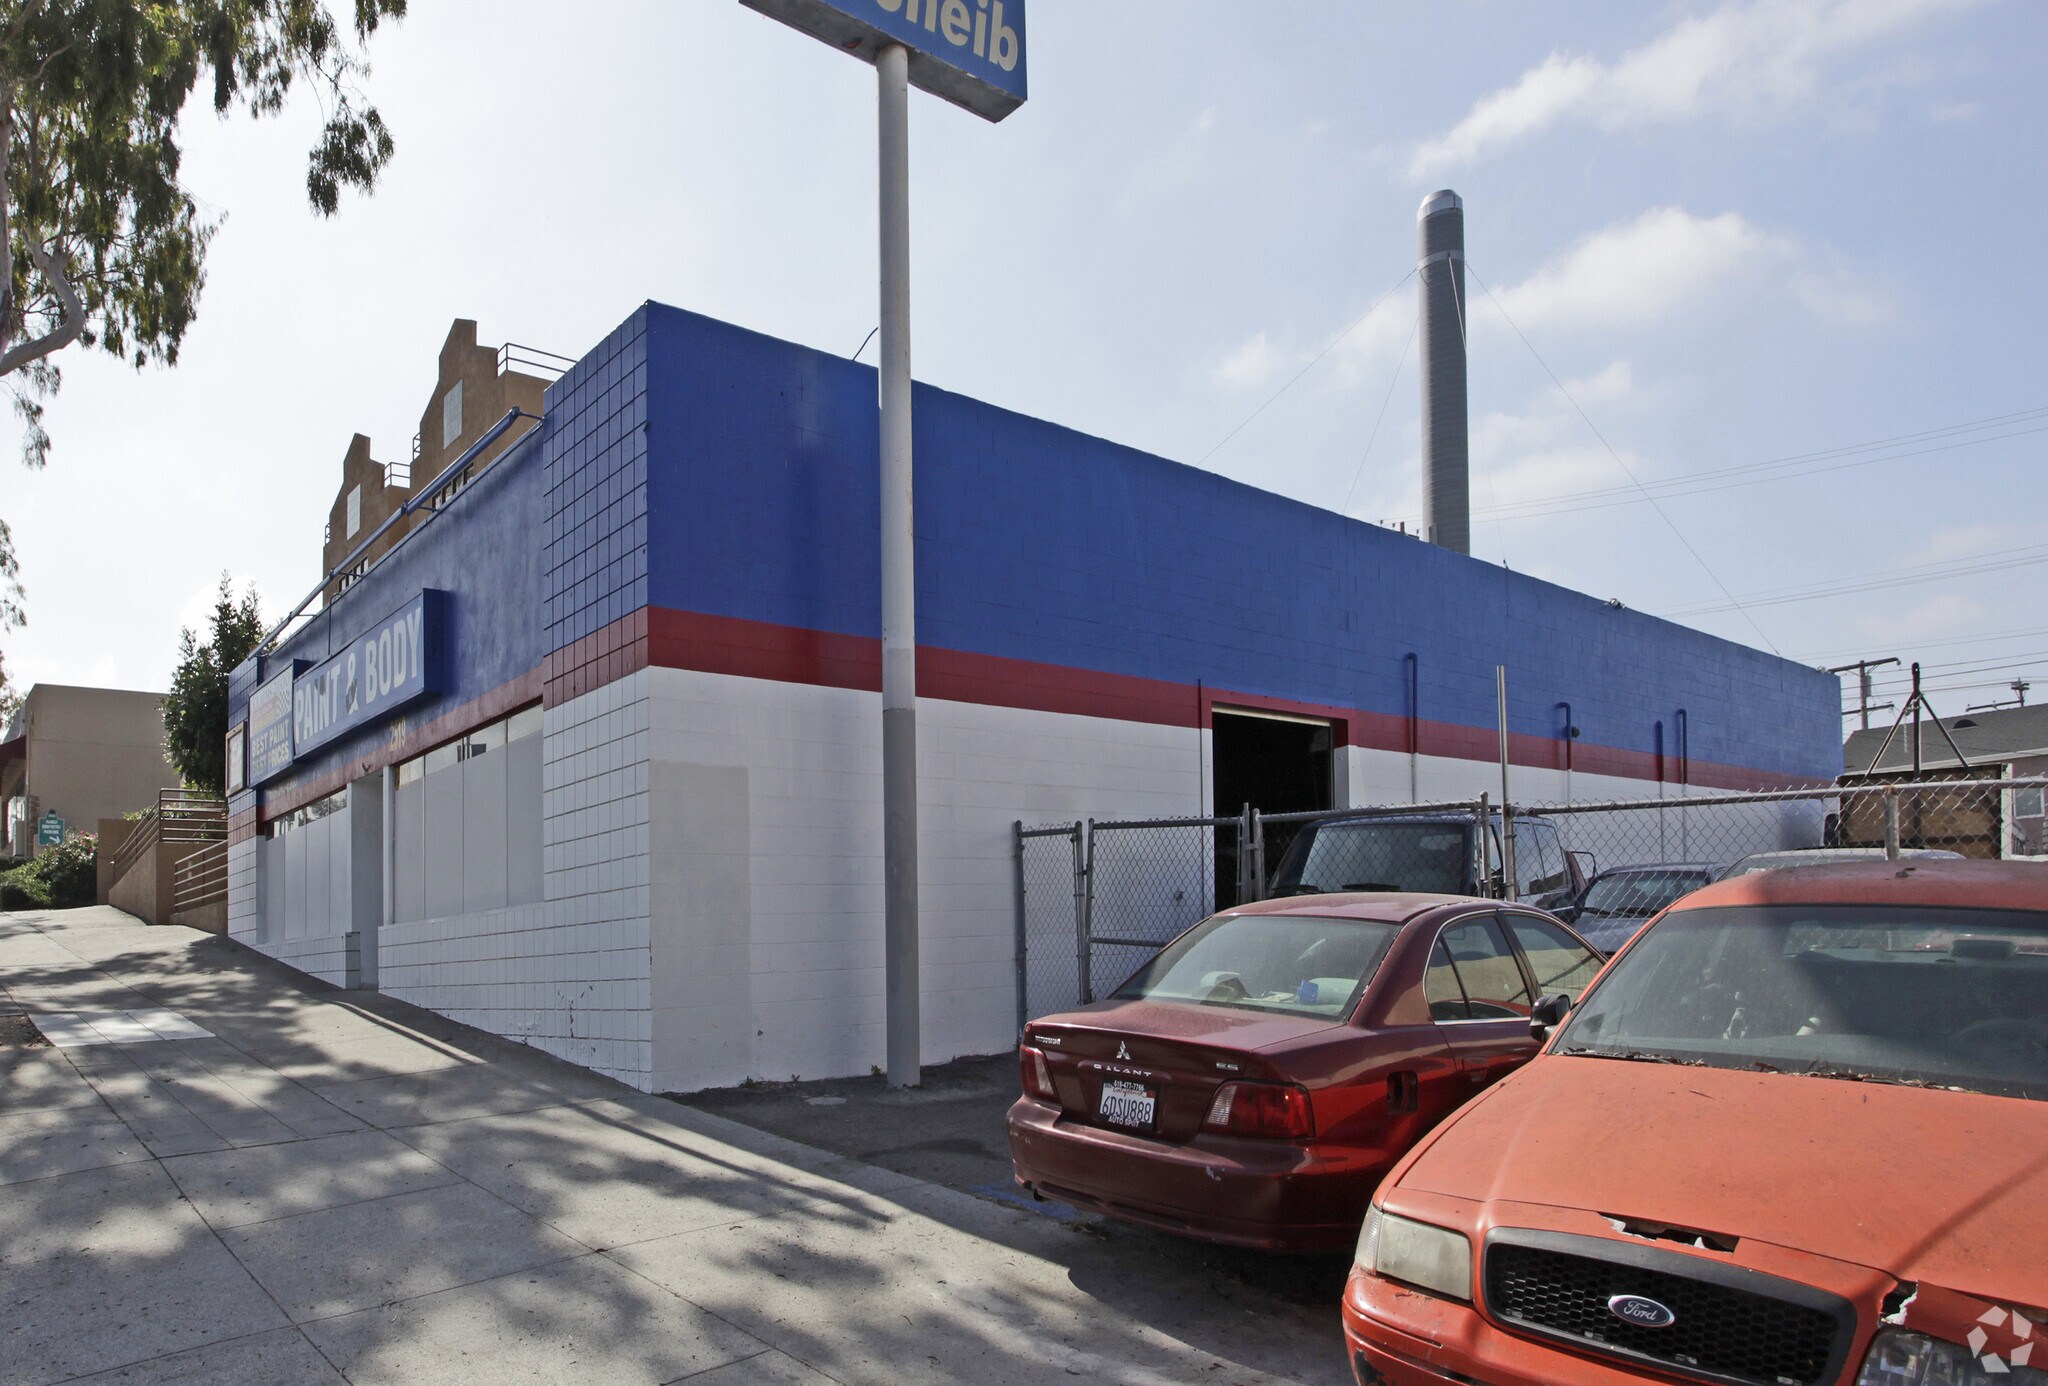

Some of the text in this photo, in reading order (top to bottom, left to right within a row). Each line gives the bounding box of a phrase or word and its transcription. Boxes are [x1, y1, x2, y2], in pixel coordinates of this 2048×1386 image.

[874, 0, 1018, 72] eib
[295, 663, 340, 744] PAINT
[346, 652, 359, 715] &
[366, 606, 421, 705] BODY
[252, 732, 269, 759] BEST
[269, 719, 289, 748] PAINT
[268, 740, 289, 769] PRICES
[1094, 1063, 1152, 1077] GALANT
[1101, 1095, 1152, 1122] 6DSU888
[1108, 1115, 1140, 1128] AUTO SPOT
[1623, 1300, 1658, 1321] Ford
